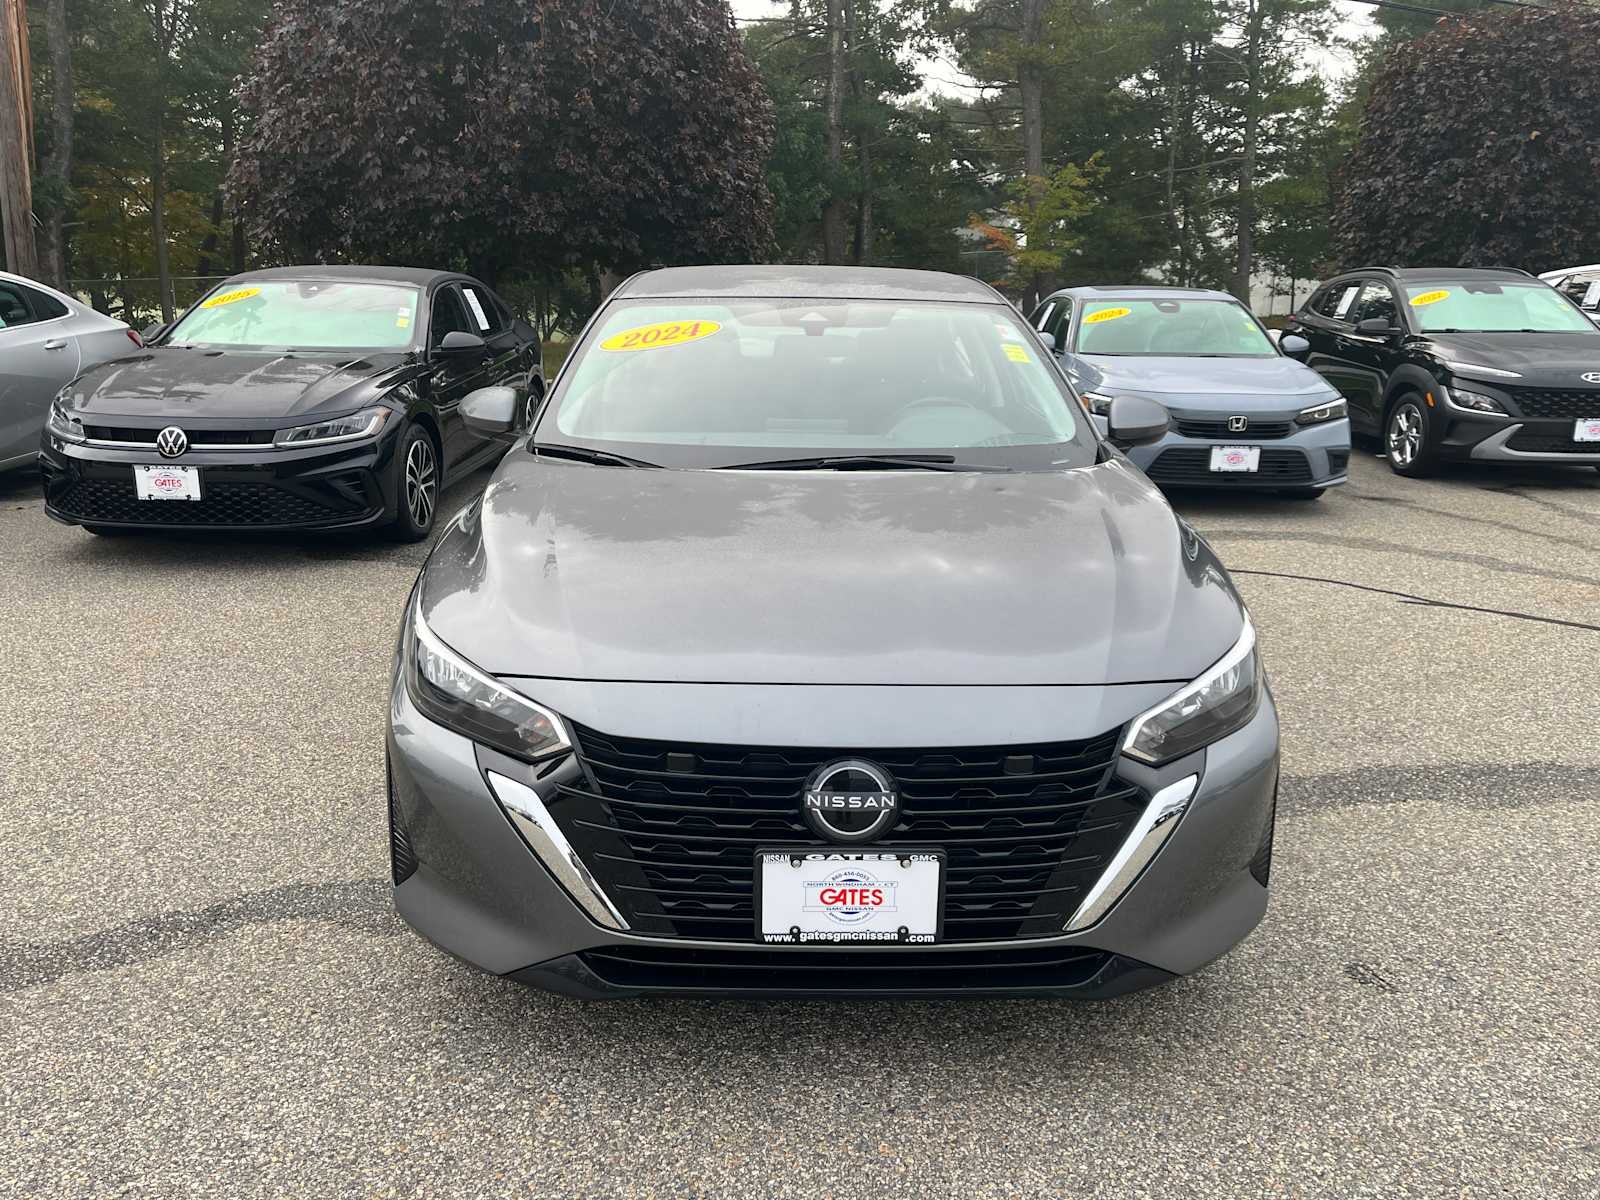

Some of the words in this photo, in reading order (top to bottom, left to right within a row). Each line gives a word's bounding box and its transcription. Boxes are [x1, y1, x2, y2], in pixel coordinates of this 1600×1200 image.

[621, 322, 701, 348] 2024
[154, 478, 183, 488] GATES
[807, 795, 895, 808] NISSAN
[763, 854, 791, 864] NISSAN
[819, 888, 883, 906] GATES
[763, 934, 796, 943] www.
[799, 930, 899, 942] gatesgmcnissan
[905, 934, 935, 943] .com
